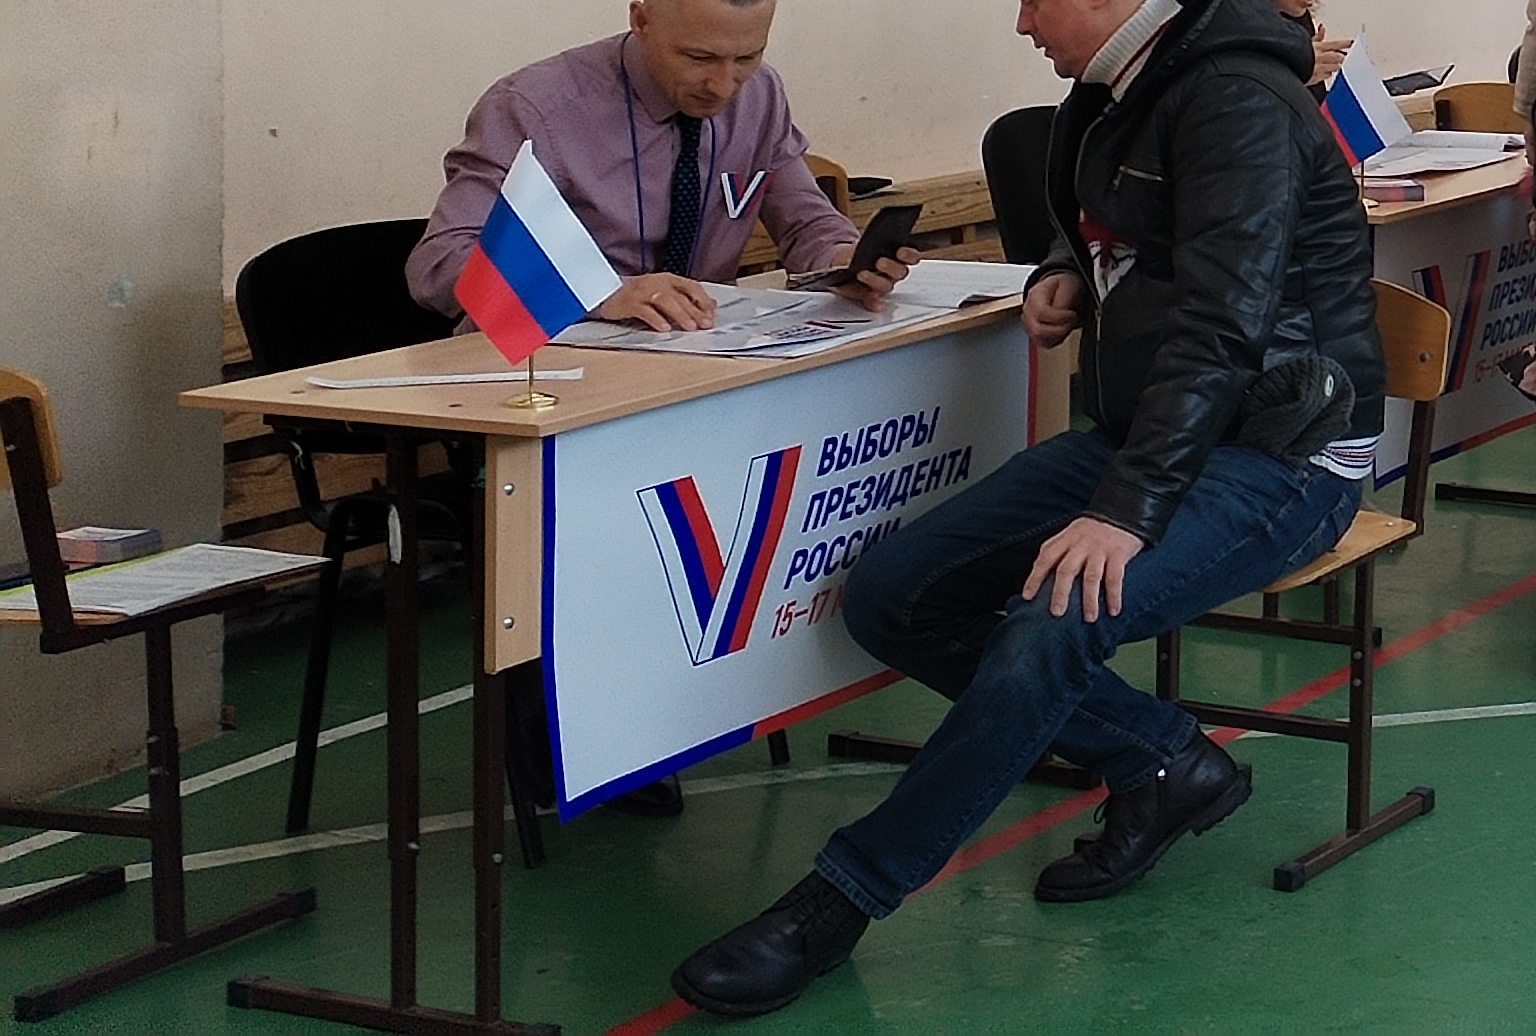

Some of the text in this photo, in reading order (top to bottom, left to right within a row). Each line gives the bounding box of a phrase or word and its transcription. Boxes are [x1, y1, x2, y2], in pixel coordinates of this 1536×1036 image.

[1487, 272, 1536, 311] ПРЕЗИ
[816, 405, 941, 478] ВЫБОРЫ
[801, 445, 972, 533] ПРЕЗИДЕНТА
